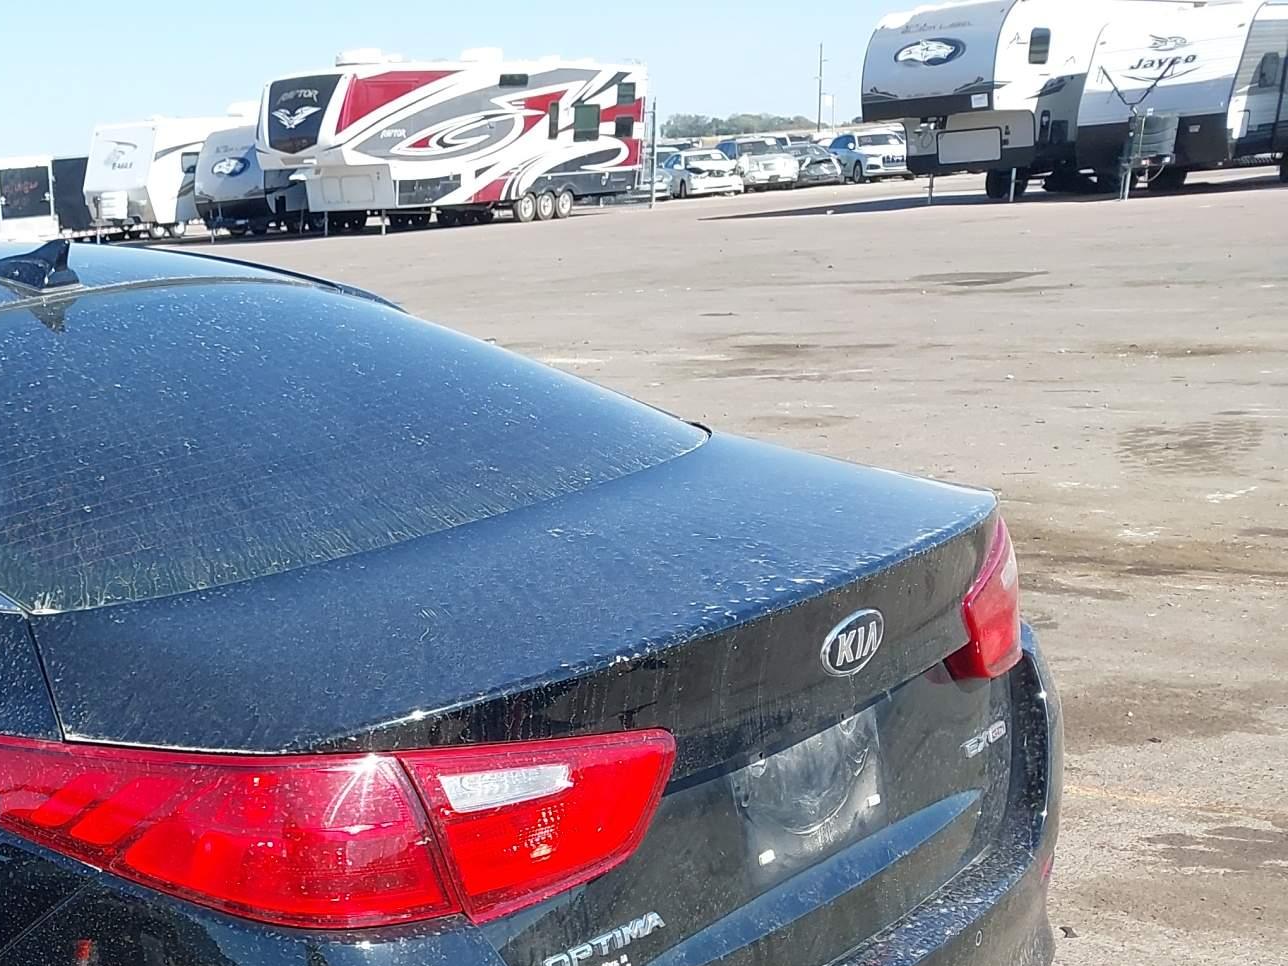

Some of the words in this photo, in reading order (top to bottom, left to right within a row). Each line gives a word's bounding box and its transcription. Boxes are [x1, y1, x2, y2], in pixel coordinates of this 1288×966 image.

[1128, 54, 1197, 71] Jayco
[277, 88, 319, 105] RAPTOR
[835, 620, 878, 667] KIA
